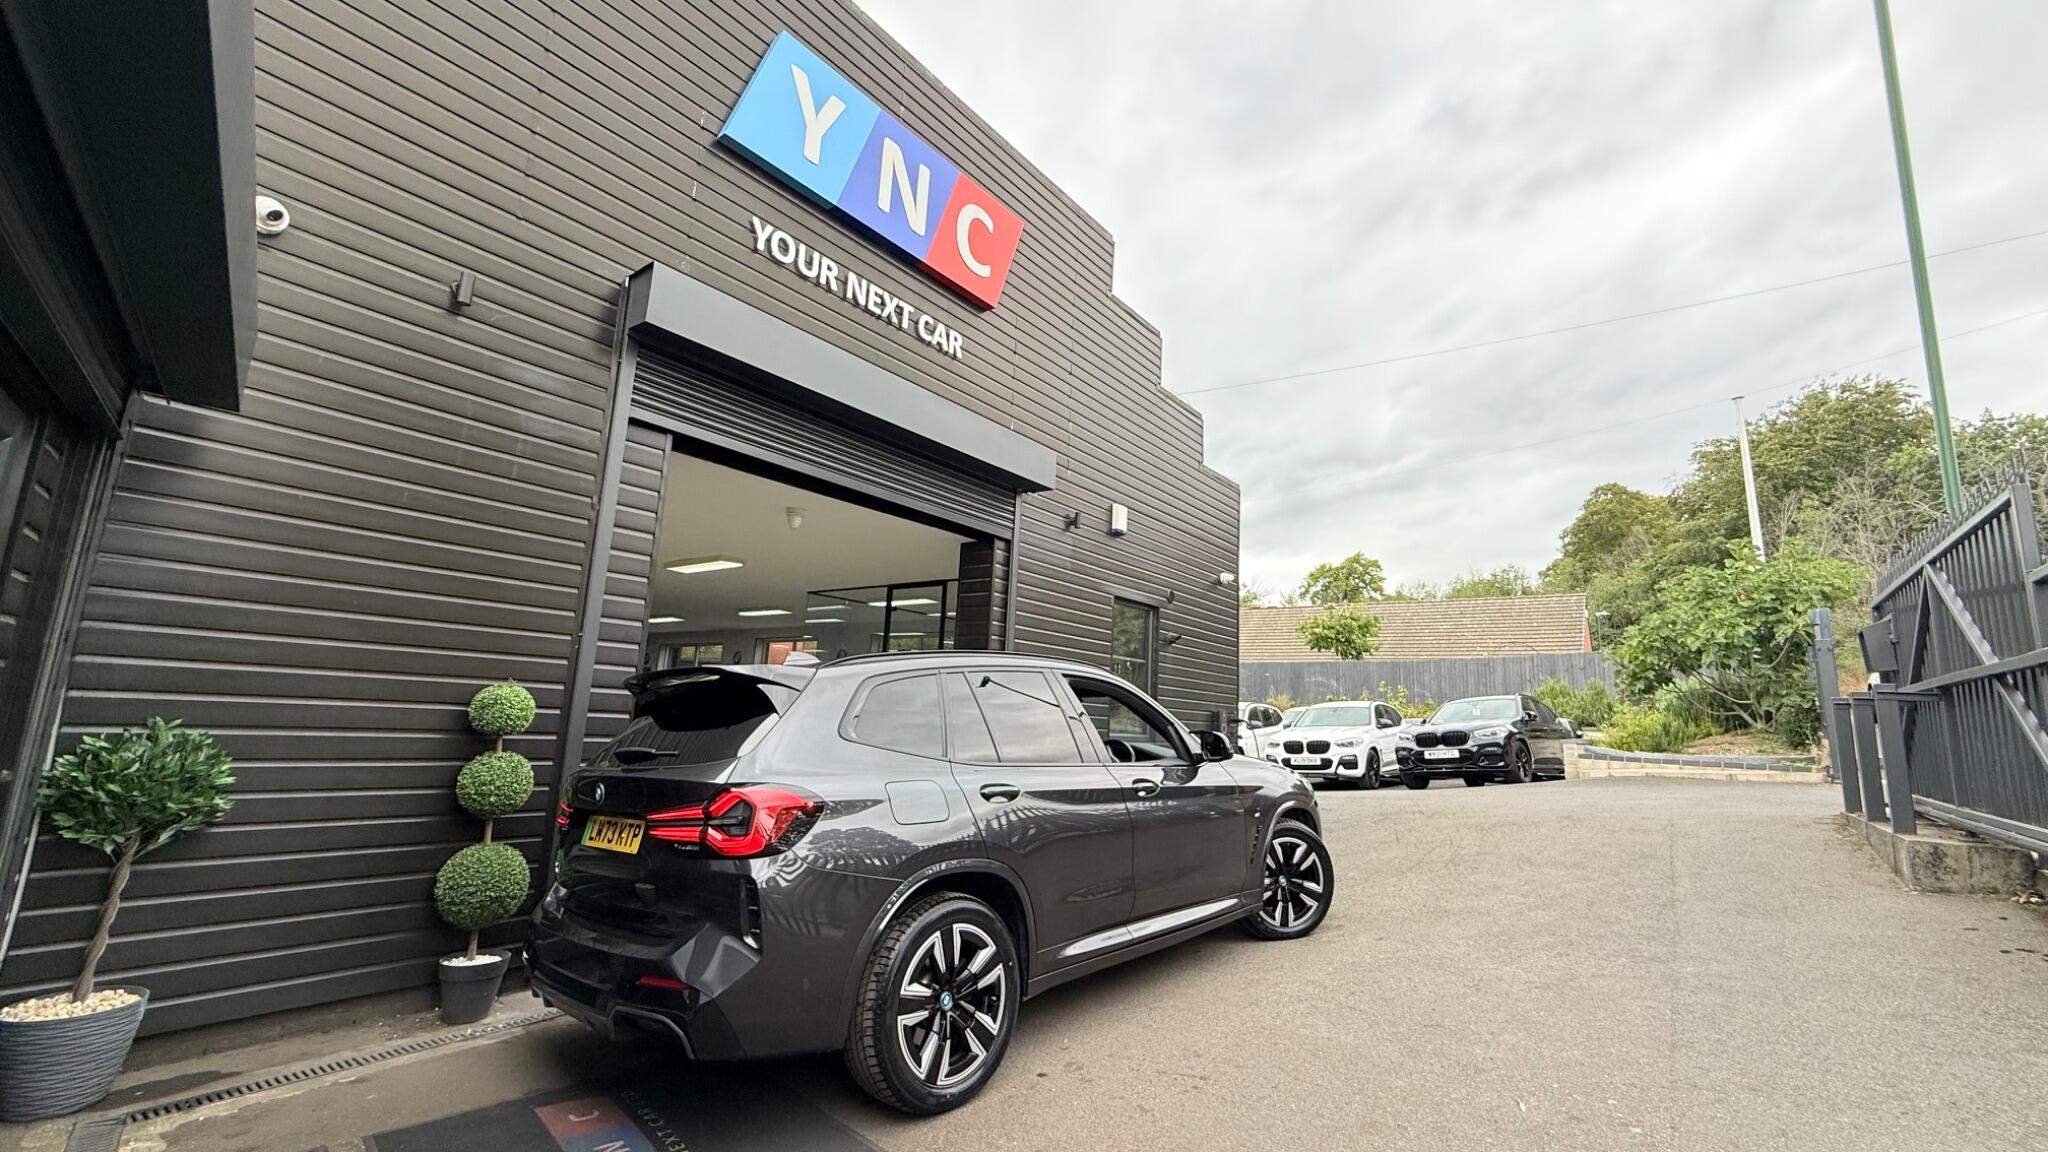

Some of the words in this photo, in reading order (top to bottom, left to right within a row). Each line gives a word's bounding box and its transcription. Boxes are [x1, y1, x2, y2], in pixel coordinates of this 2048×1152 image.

[791, 63, 995, 278] YNC
[752, 215, 839, 292] YOUR
[846, 271, 914, 330] NEXT
[918, 313, 964, 360] CAR
[588, 818, 618, 844] LX73
[615, 821, 642, 848] KTP
[656, 1129, 689, 1152] EXT
